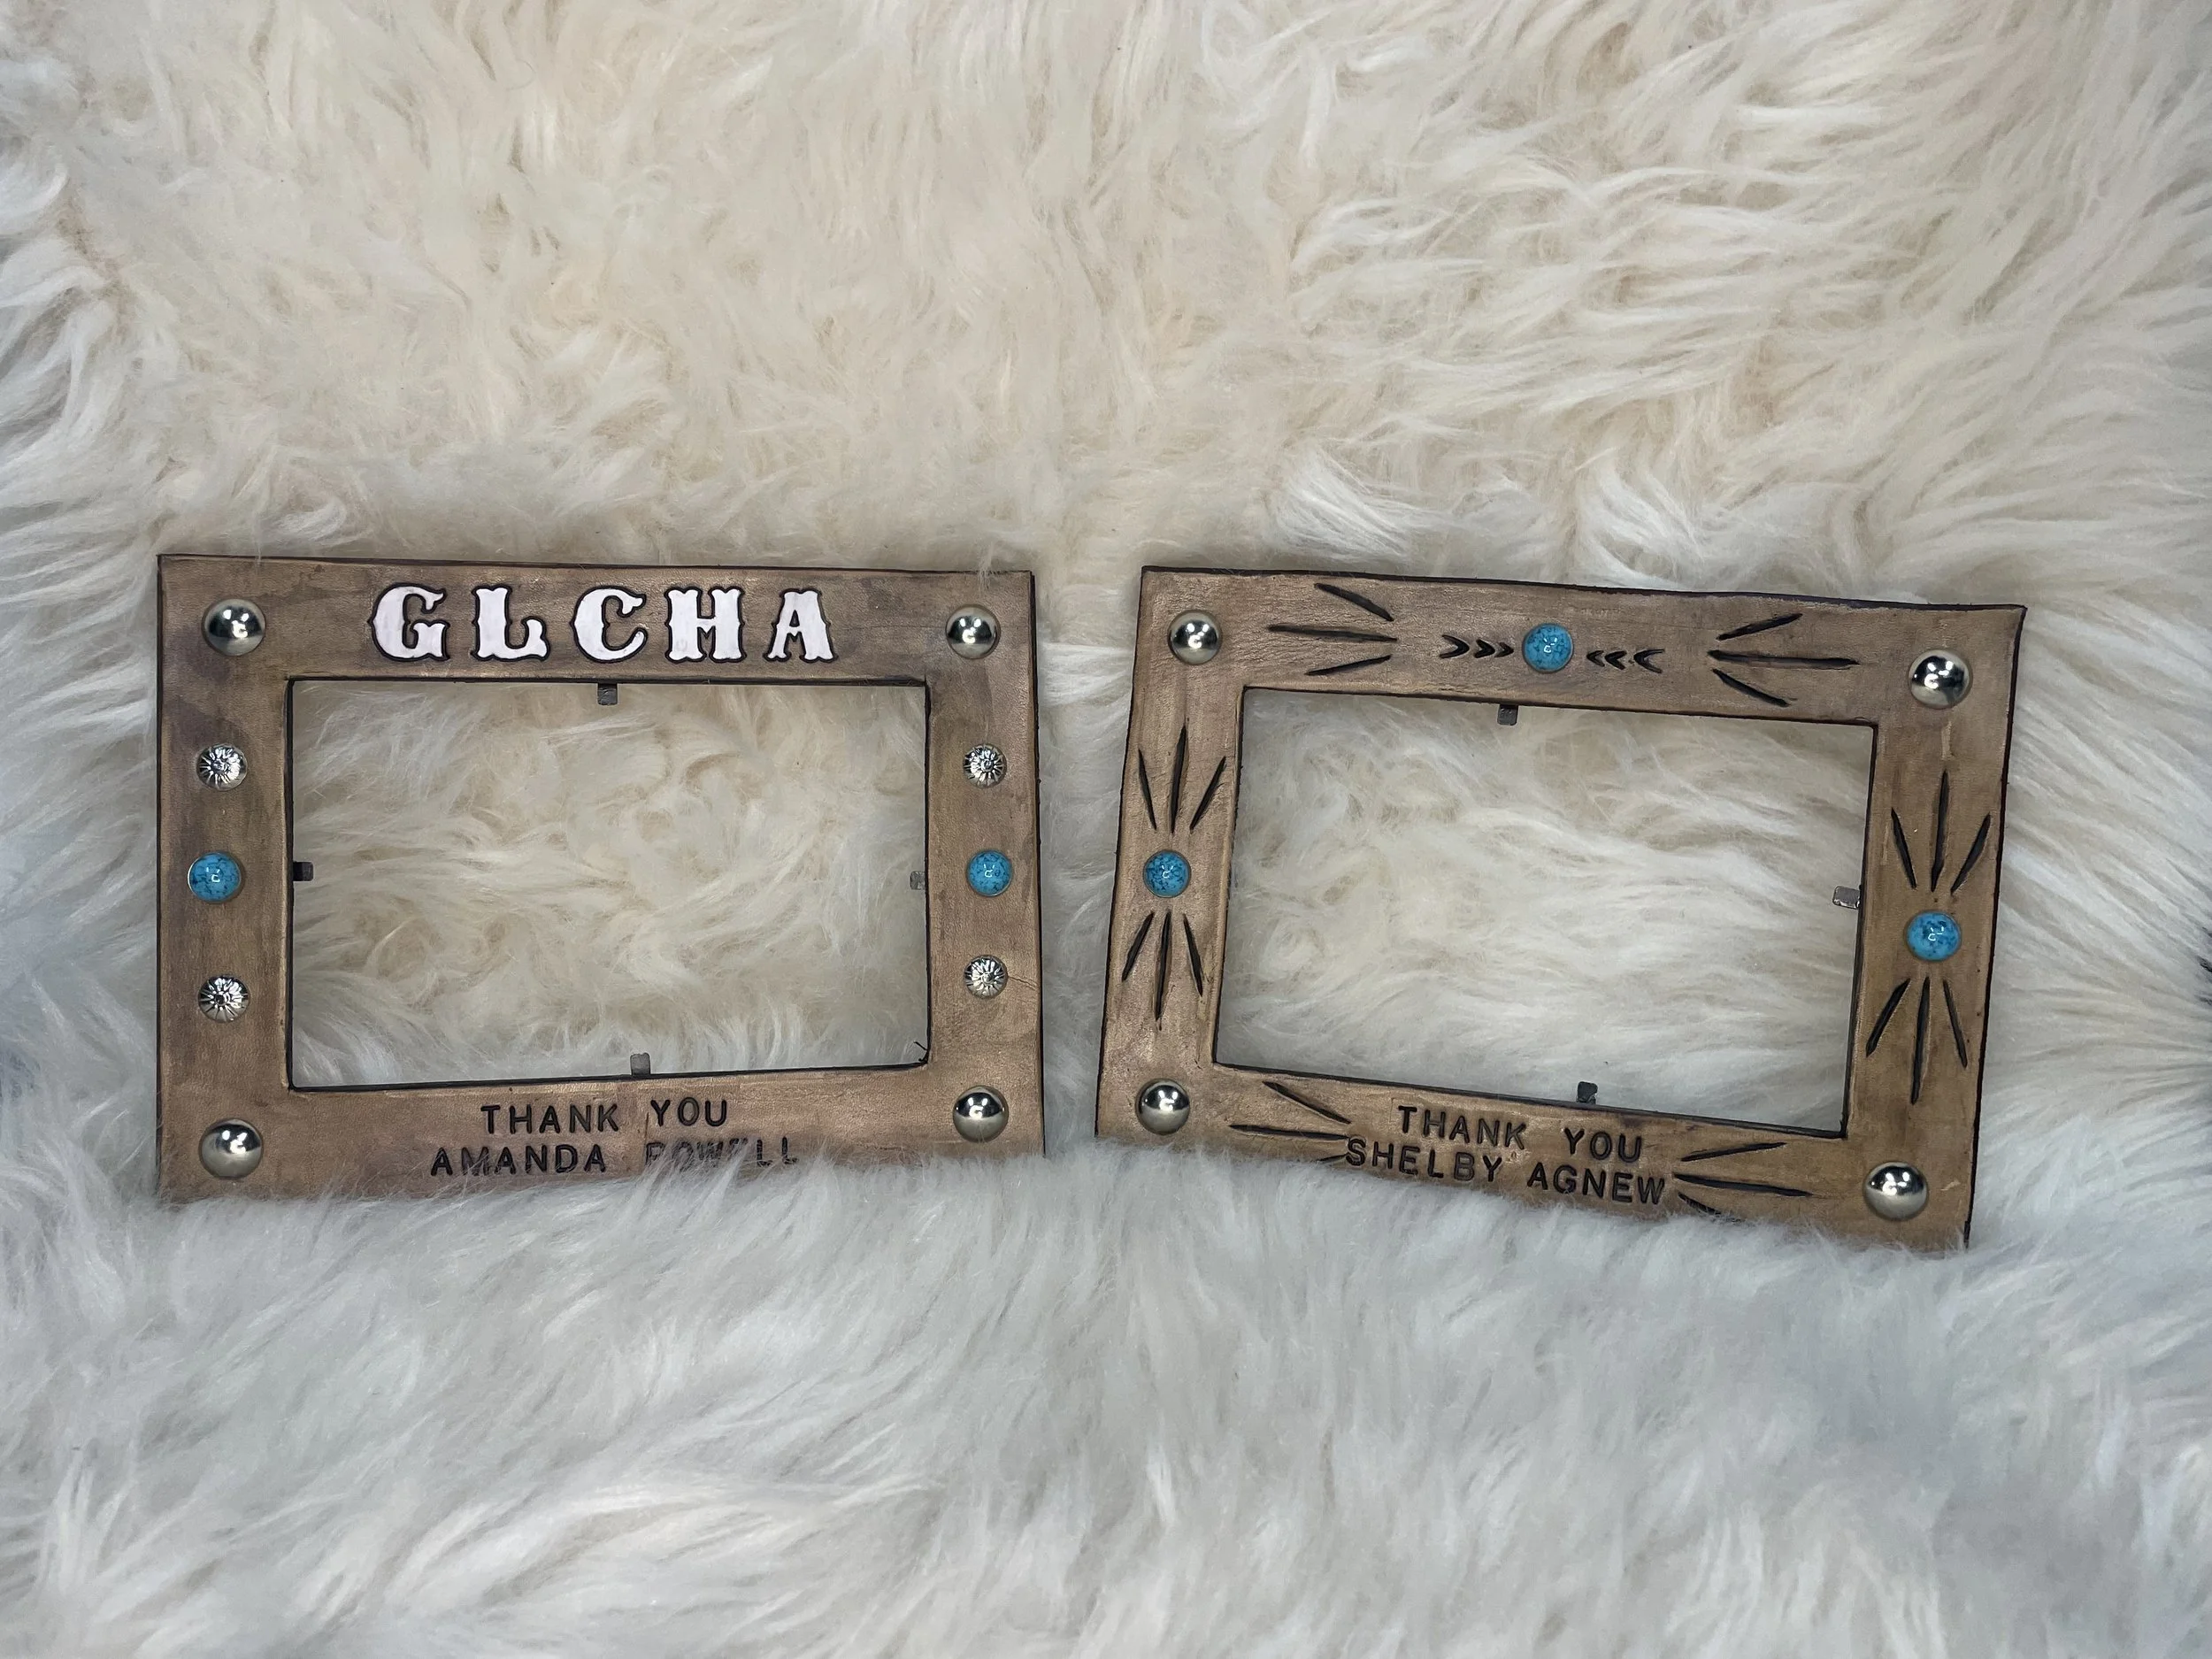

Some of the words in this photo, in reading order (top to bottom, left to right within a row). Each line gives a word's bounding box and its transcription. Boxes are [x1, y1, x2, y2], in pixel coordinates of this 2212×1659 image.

[368, 582, 839, 664] GLCHA
[480, 1104, 619, 1134] THANK
[650, 1096, 728, 1127] YOU
[1398, 1105, 1527, 1150] THANK
[1563, 1127, 1643, 1164] YOU
[430, 1144, 607, 1177] AMANDA
[1345, 1137, 1504, 1183] SHELBY
[1526, 1161, 1666, 1205] AGNEW
